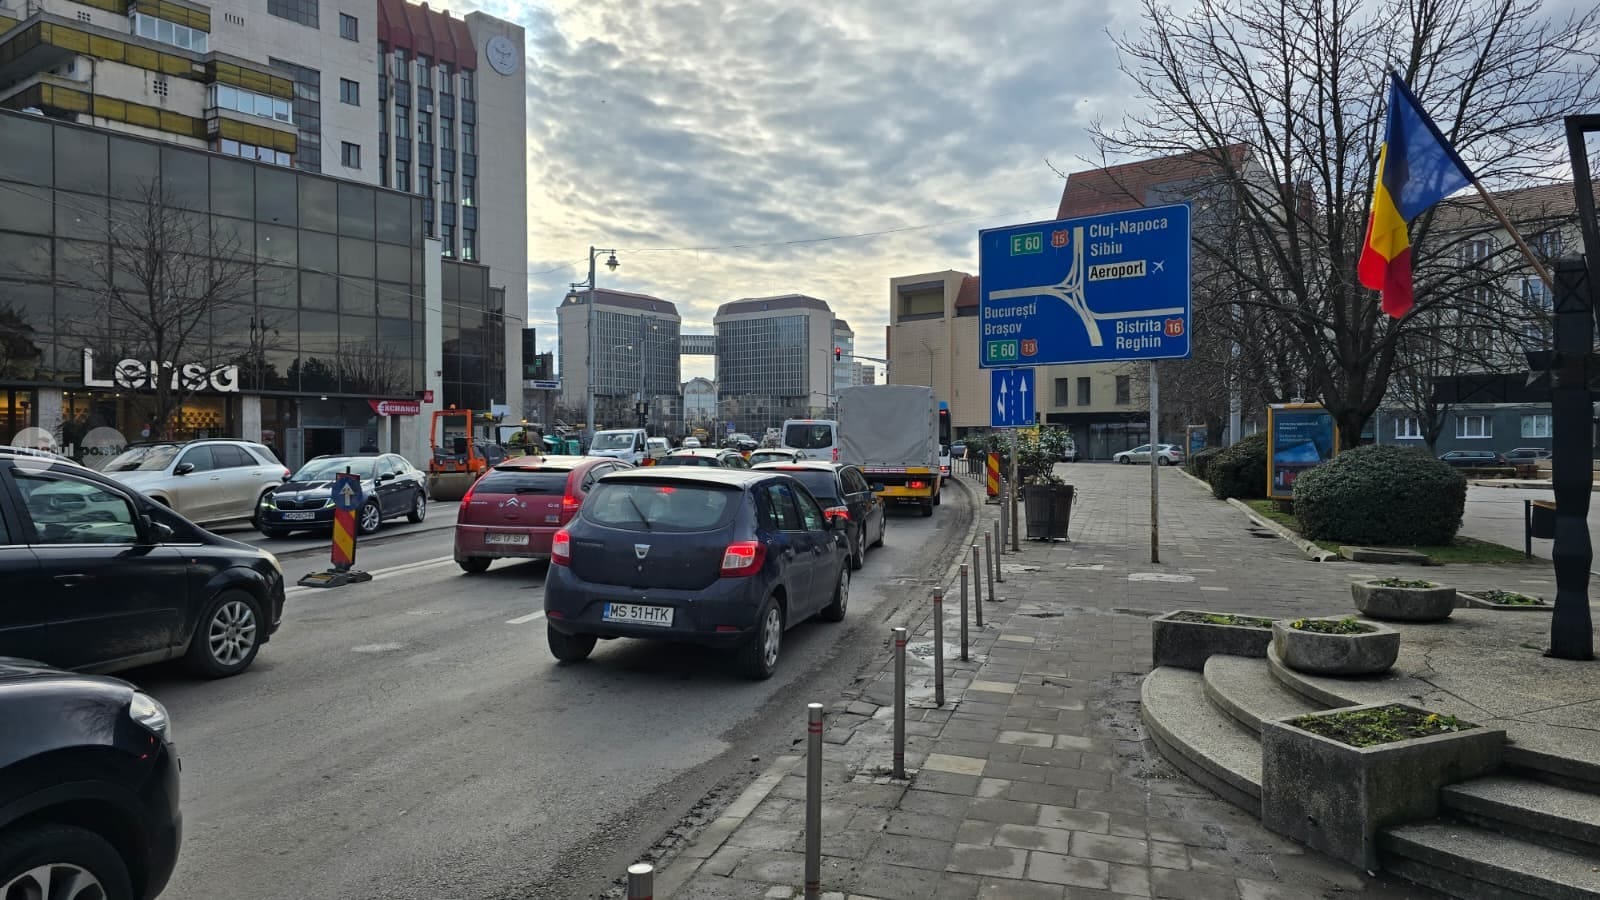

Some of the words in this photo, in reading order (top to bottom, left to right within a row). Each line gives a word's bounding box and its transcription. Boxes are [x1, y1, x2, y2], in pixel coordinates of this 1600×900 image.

[1089, 218, 1168, 238] Cluj-Napoca
[1014, 239, 1021, 252] E
[1025, 236, 1040, 250] 60
[1055, 233, 1065, 245] 15
[1090, 241, 1123, 256] Sibiu
[1090, 261, 1144, 279] Aeroport
[984, 302, 1037, 320] București
[984, 323, 1022, 337] Brașov
[1116, 319, 1161, 334] Bistrita
[1168, 322, 1181, 333] 16
[990, 344, 998, 358] E
[1001, 343, 1015, 357] 60
[1023, 343, 1035, 353] 13
[1116, 335, 1162, 352] Reghin
[84, 348, 240, 392] Lensa
[610, 605, 627, 617] MS
[631, 606, 643, 619] 51
[644, 607, 670, 621] HTK
